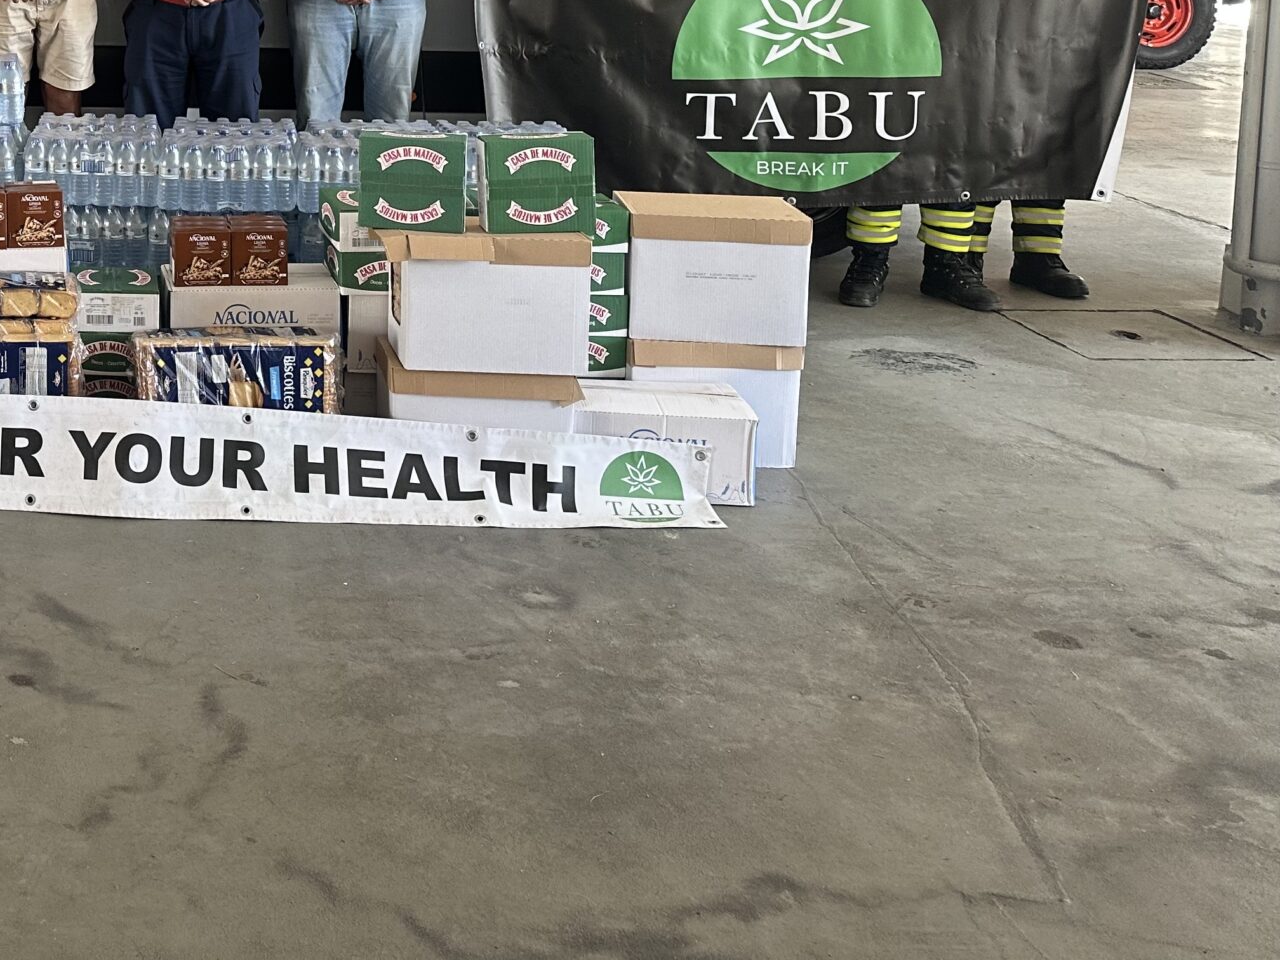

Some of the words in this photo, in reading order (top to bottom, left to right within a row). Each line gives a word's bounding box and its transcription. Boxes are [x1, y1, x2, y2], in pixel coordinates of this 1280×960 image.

[685, 91, 926, 141] TABU
[383, 149, 401, 163] CASA
[402, 147, 412, 158] DE
[413, 147, 443, 166] MATEUS
[510, 152, 529, 166] CASA
[531, 148, 539, 159] DE
[541, 147, 572, 165] MATEUS
[756, 160, 825, 177] BREAK
[832, 161, 849, 176] IT
[379, 205, 408, 222] MATEUS
[409, 213, 419, 222] DE
[420, 205, 440, 221] CASA
[512, 207, 541, 223] MATEUS
[543, 213, 552, 223] DE
[553, 206, 572, 221] CASA
[360, 263, 377, 277] CASA
[213, 305, 298, 325] NACIONAL
[99, 342, 107, 353] DE
[99, 380, 107, 390] DE
[283, 355, 296, 409] Biscottes
[68, 430, 268, 492] YOUR
[293, 444, 578, 513] HEALTH
[605, 500, 685, 517] TABU
